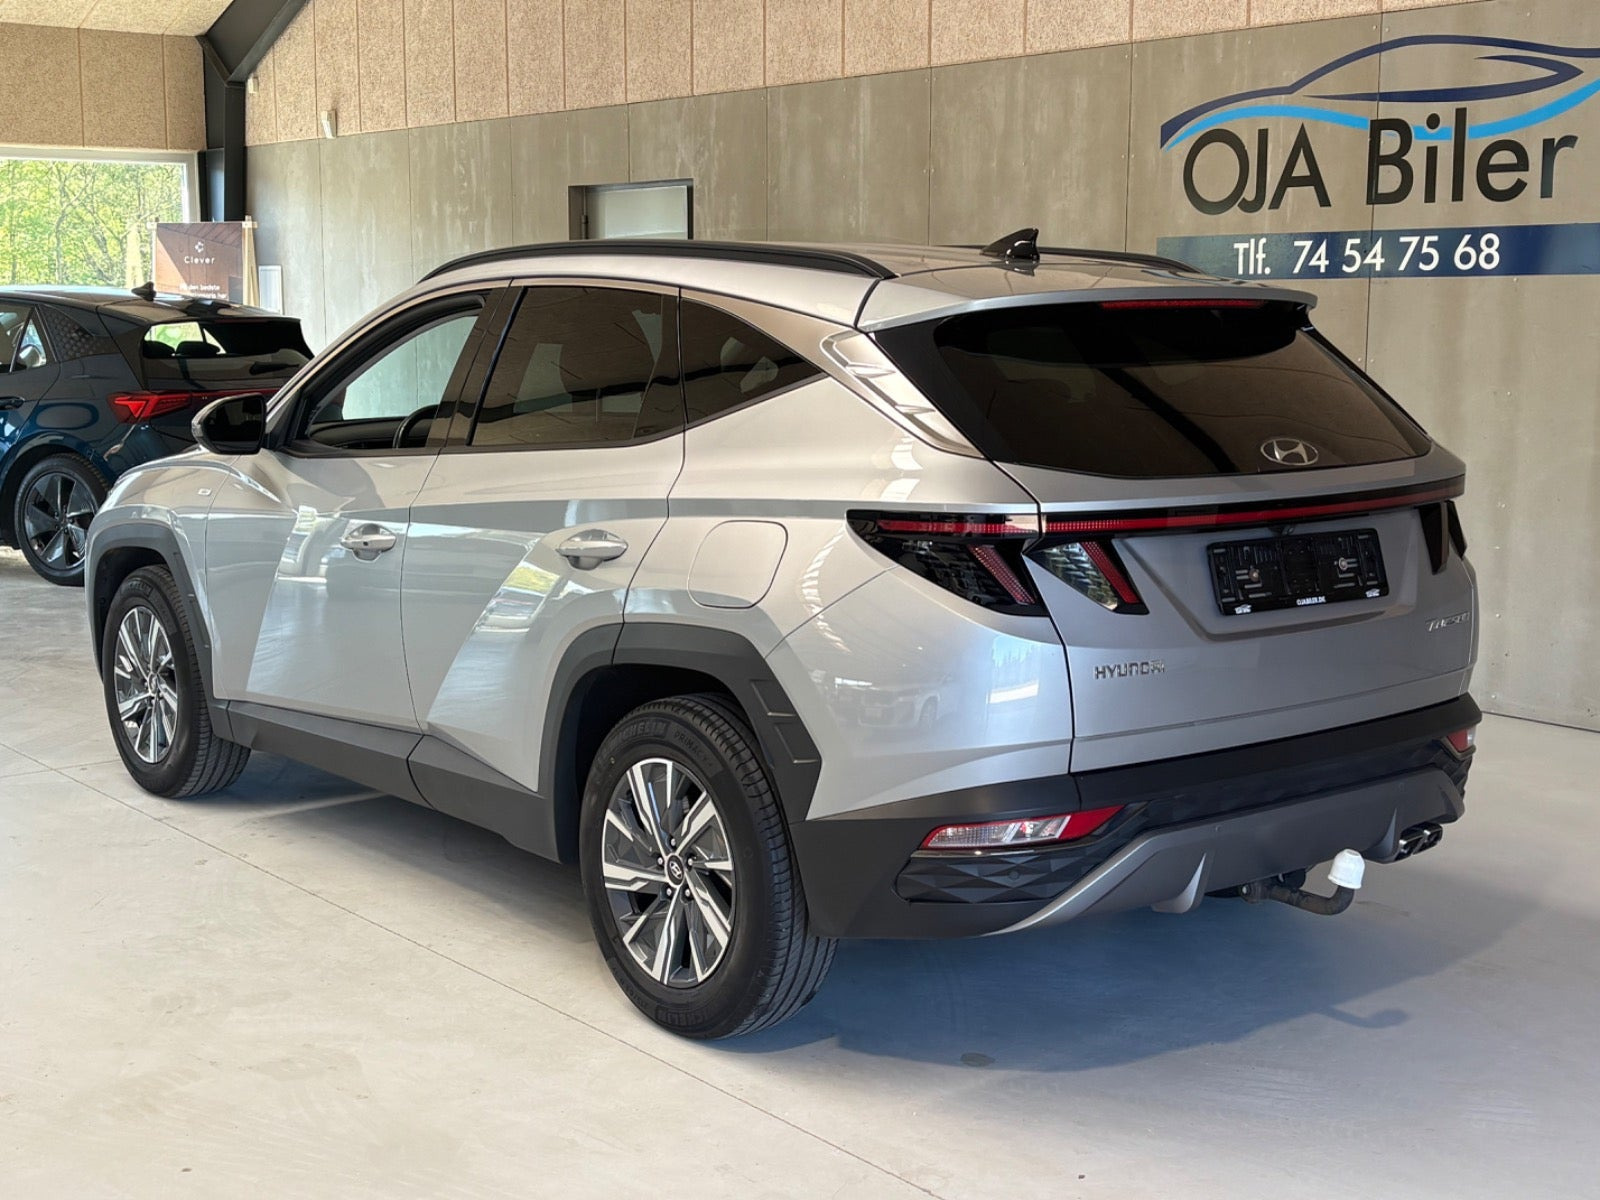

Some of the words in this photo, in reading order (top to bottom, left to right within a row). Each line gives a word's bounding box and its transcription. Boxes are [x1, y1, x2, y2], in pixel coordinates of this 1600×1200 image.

[1183, 123, 1332, 215] OJA
[1366, 107, 1579, 205] Biler
[184, 256, 216, 265] Clever
[1233, 238, 1271, 276] Tlf.
[1293, 240, 1329, 274] 74
[1342, 237, 1385, 273] 54
[1399, 235, 1440, 271] 75
[1454, 233, 1500, 270] 68
